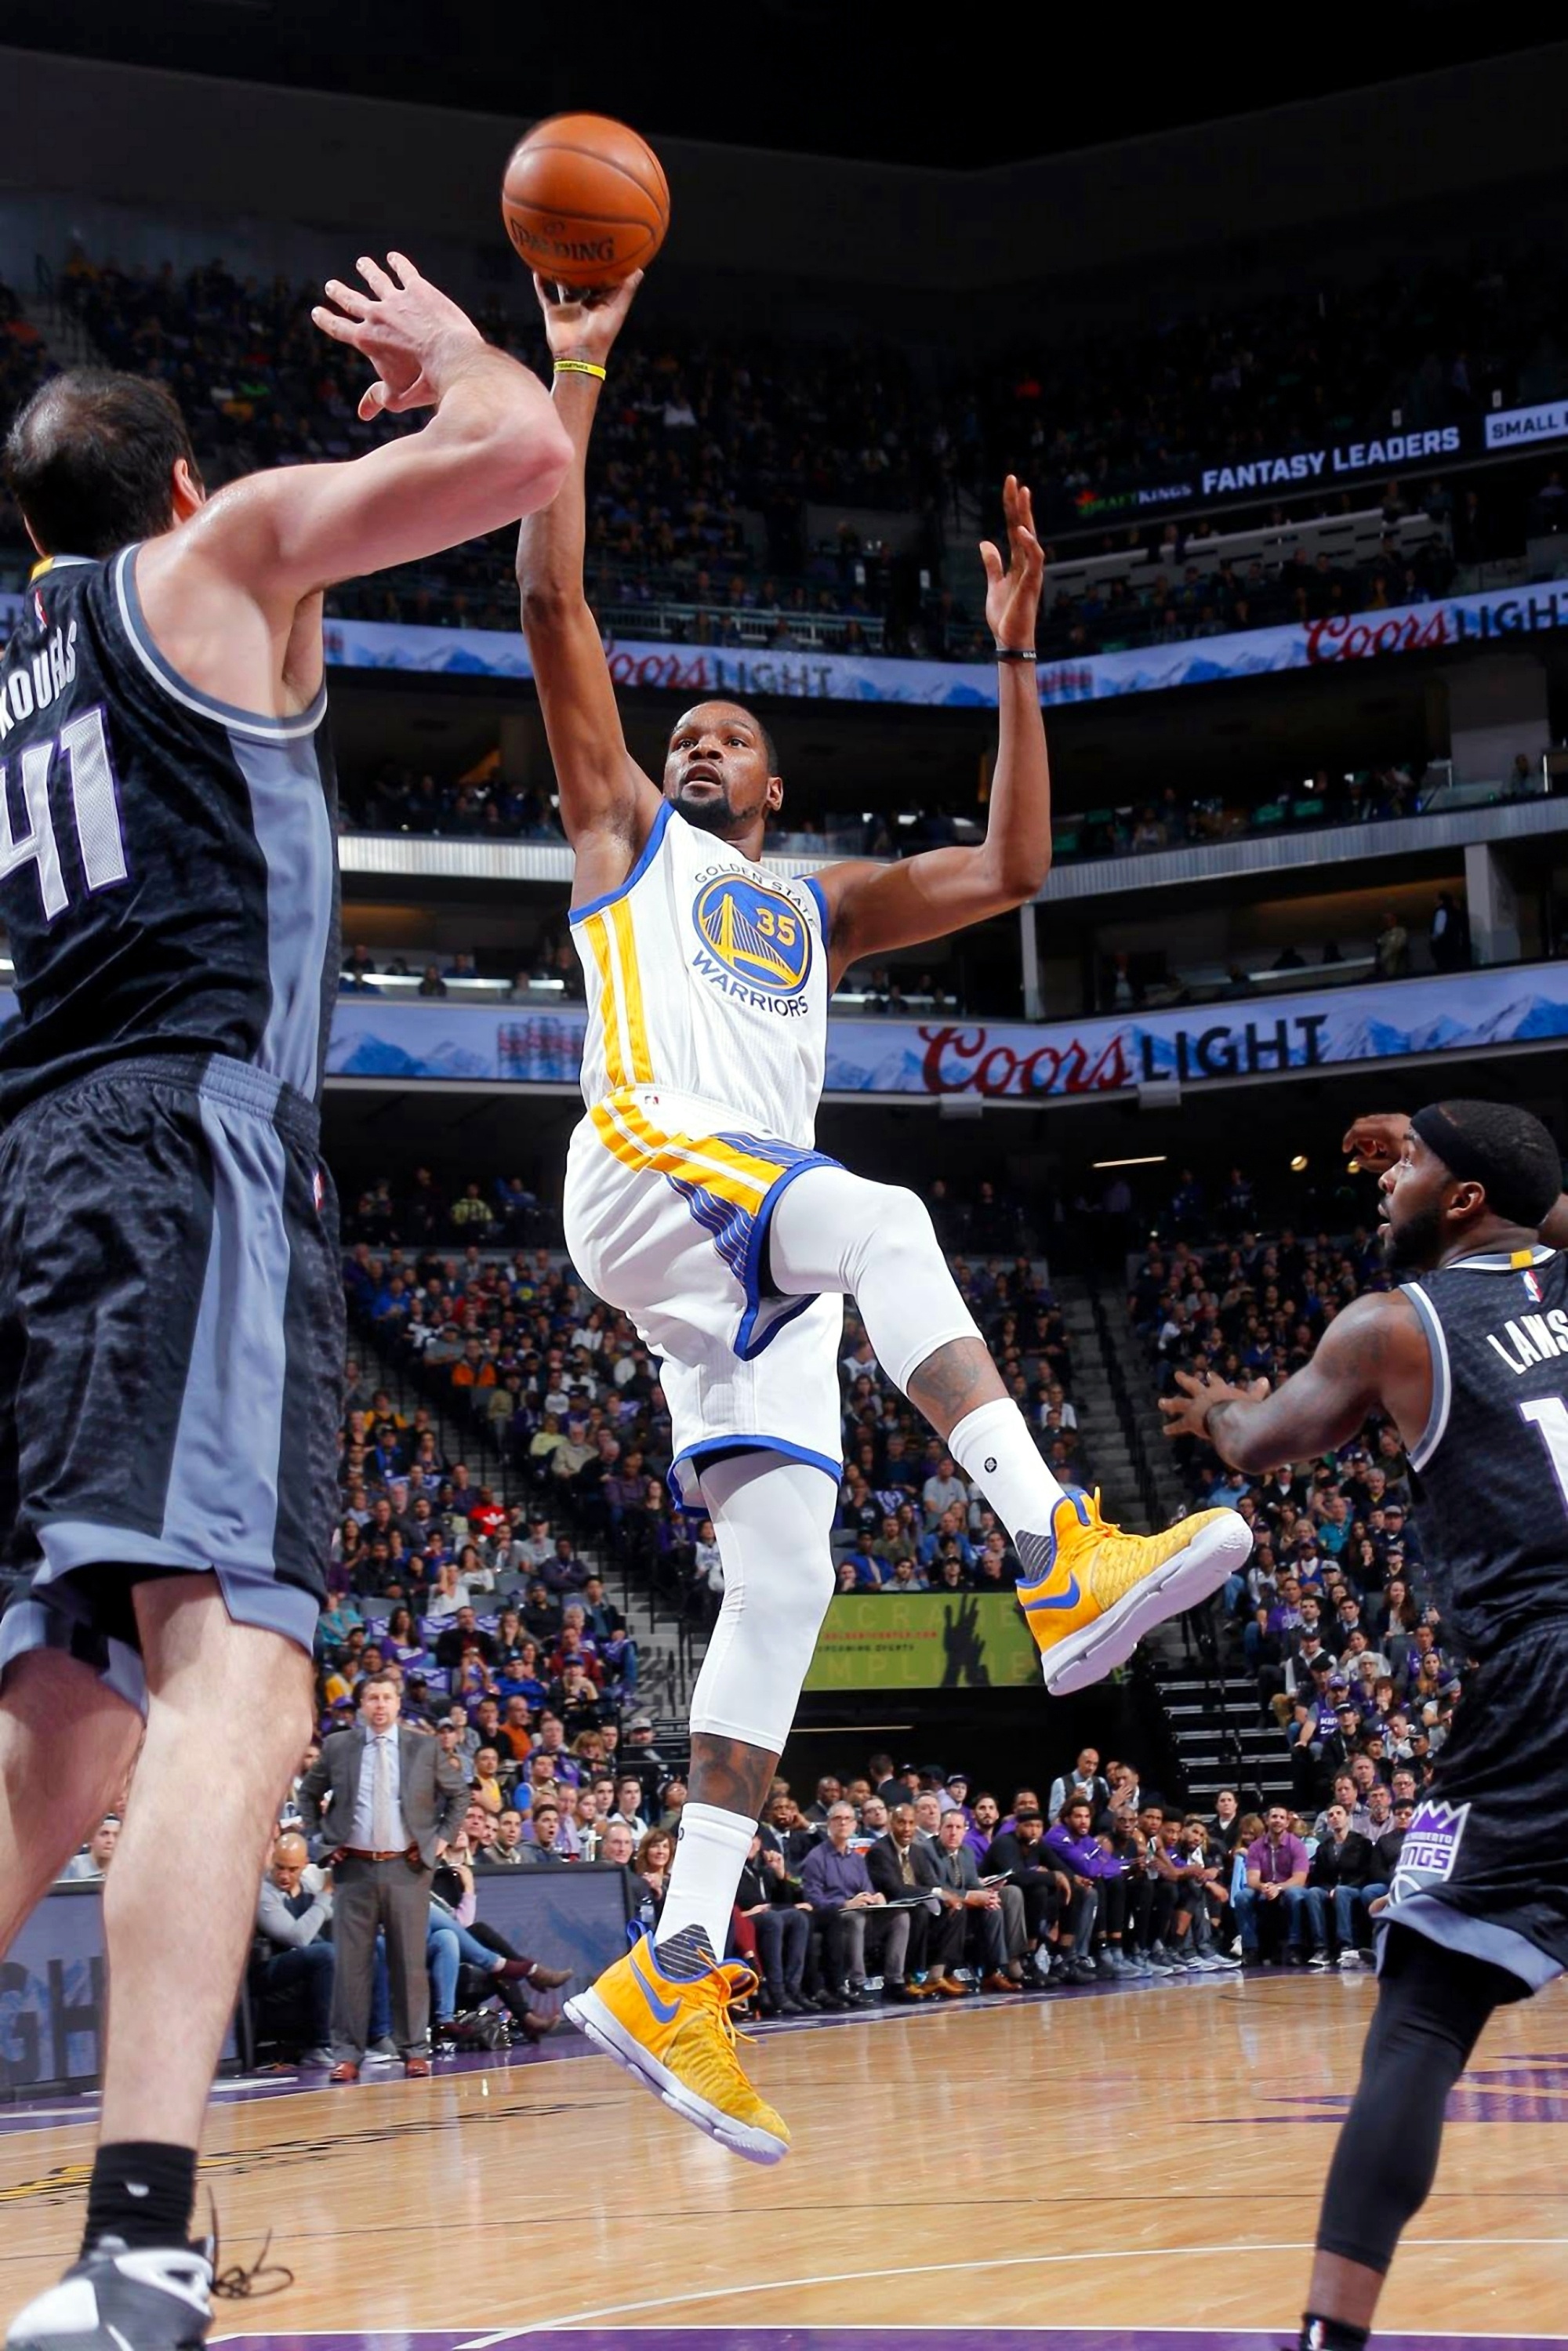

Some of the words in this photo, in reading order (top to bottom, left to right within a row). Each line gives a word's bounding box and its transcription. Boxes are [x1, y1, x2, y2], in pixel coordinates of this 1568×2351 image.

[1202, 449, 1327, 495] FANTASY
[1333, 425, 1461, 472] LEADERS
[1493, 412, 1559, 439] SMALL
[605, 627, 710, 690] oors
[716, 657, 832, 697] LIGHT
[1305, 607, 1449, 666] Coors
[1454, 593, 1568, 644] LIGH
[0, 708, 128, 922] 41
[695, 863, 763, 885] GOLDEN
[771, 880, 818, 929] STATE
[755, 907, 797, 947] 35
[692, 949, 809, 1018] WARRIORS
[919, 1025, 1134, 1096] Coors
[1141, 1014, 1328, 1082] LIGHT
